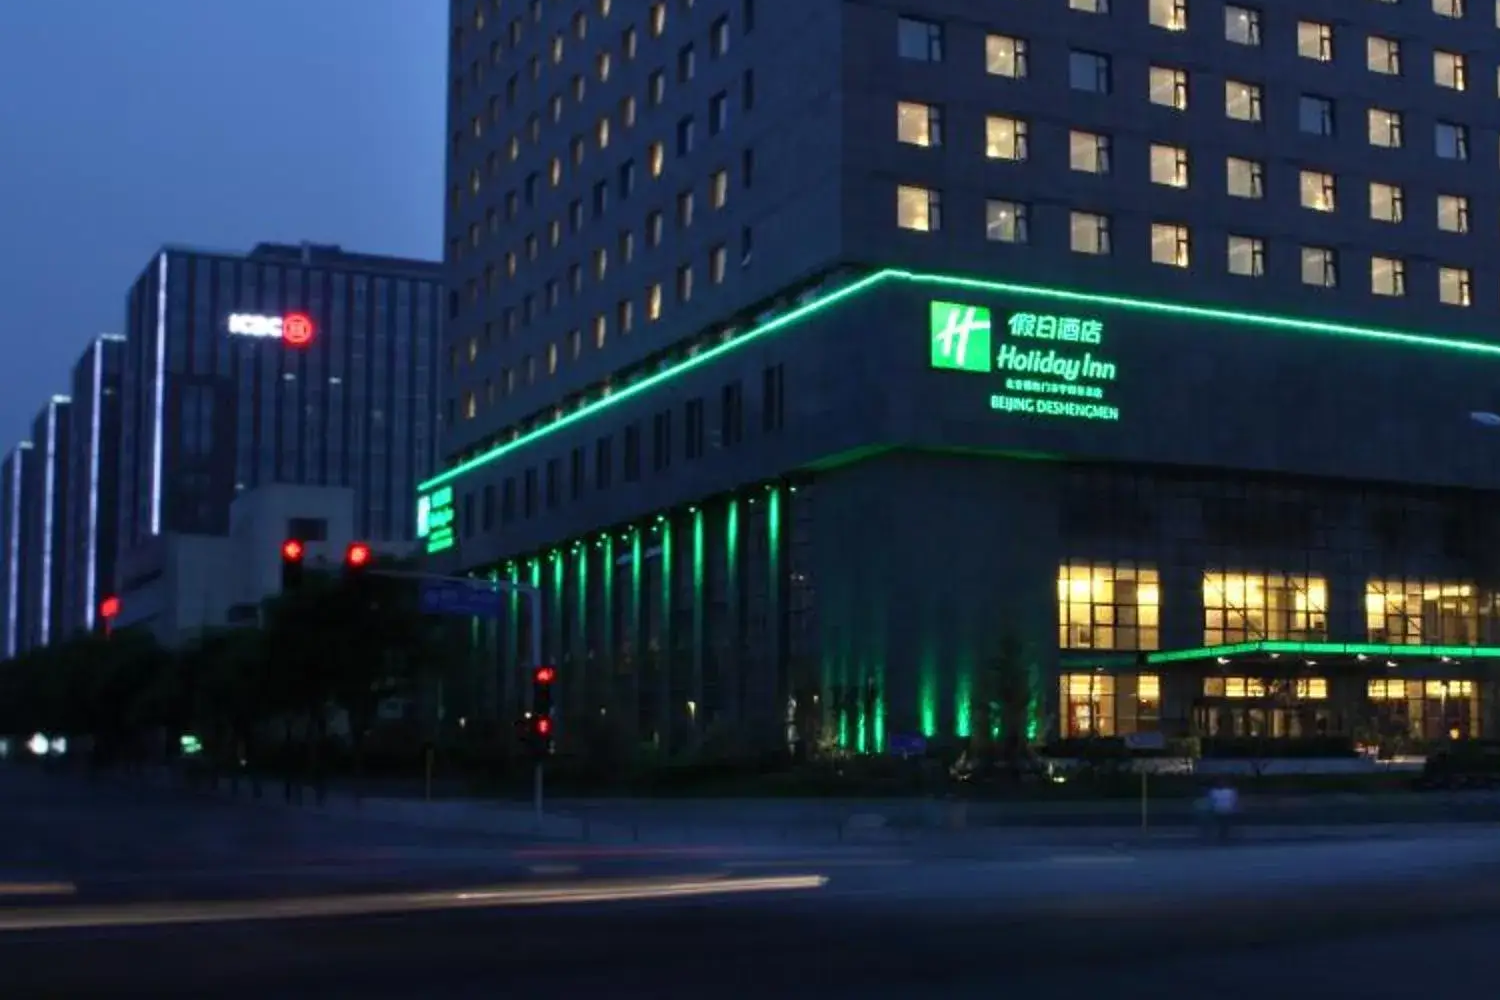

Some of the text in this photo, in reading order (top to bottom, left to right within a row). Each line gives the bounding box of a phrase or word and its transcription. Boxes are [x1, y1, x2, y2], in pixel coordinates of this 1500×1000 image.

[1007, 312, 1104, 344] 假日酒店
[996, 343, 1116, 381] Holiday Inn
[990, 395, 1119, 420] BEIJING DESHENGMEN
